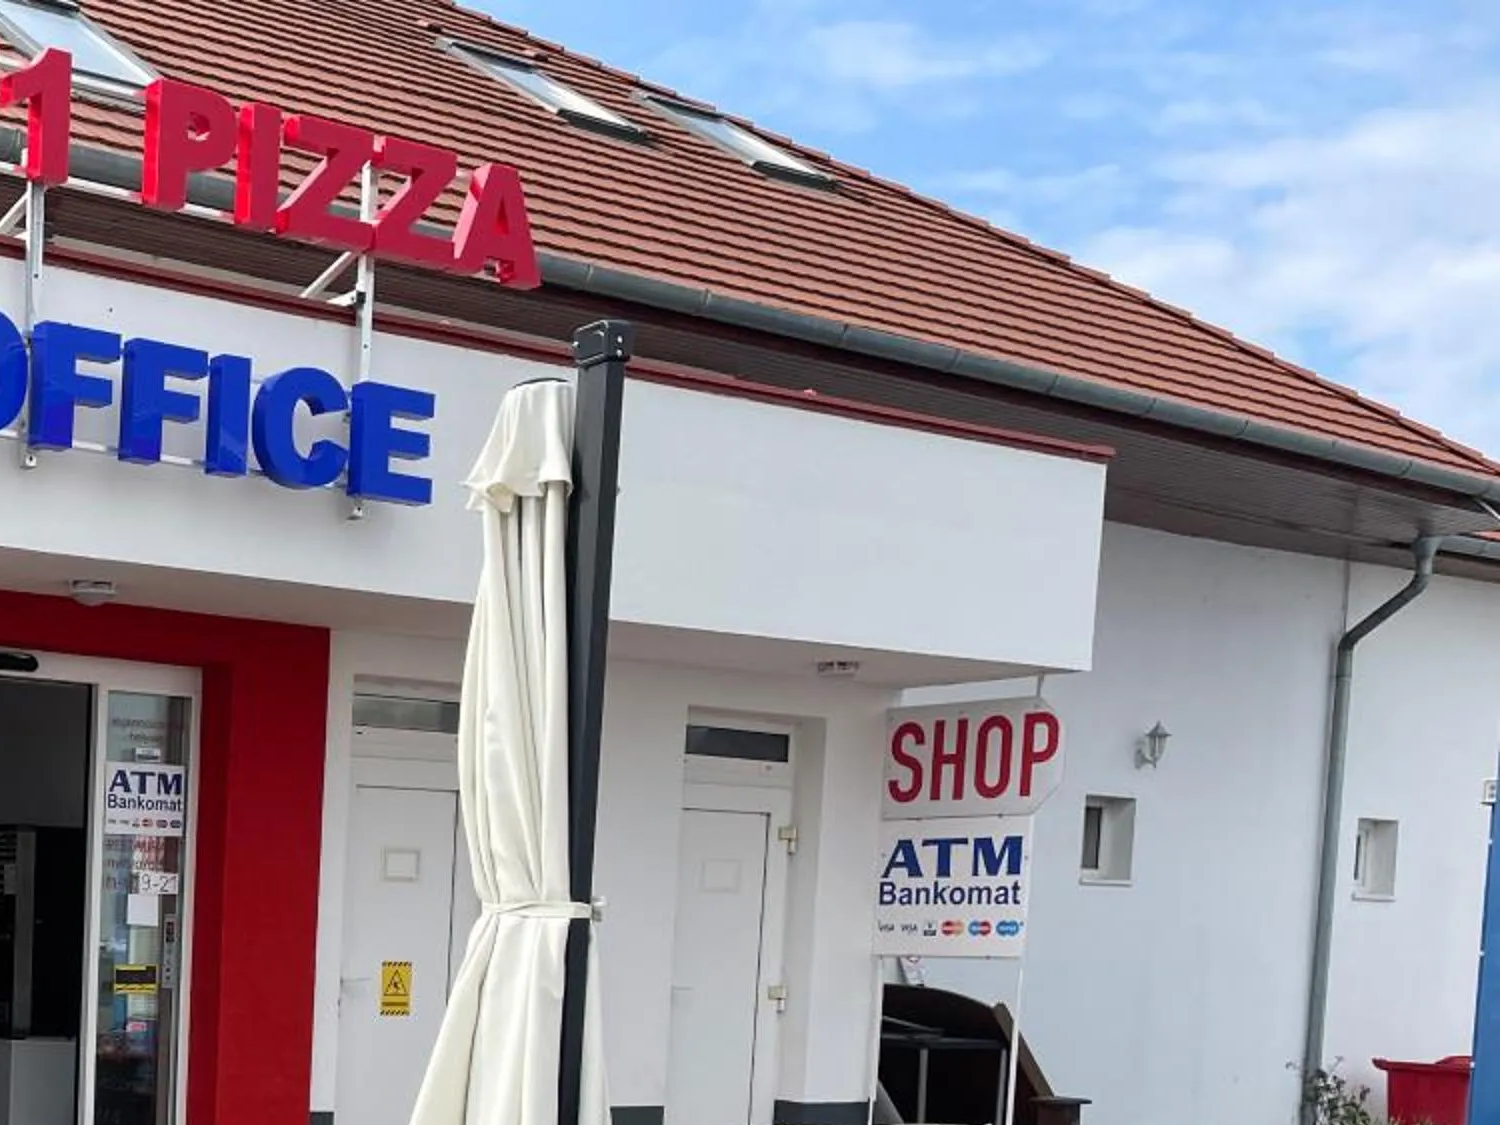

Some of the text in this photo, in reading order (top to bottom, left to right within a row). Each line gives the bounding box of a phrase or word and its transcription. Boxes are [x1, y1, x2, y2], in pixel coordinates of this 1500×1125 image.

[141, 78, 541, 290] PIZZA
[887, 711, 1060, 803] SHOP
[108, 769, 183, 796] ATM
[107, 793, 183, 813] Bankomat
[881, 835, 1024, 879] ATM
[879, 881, 1021, 906] Bankomat
